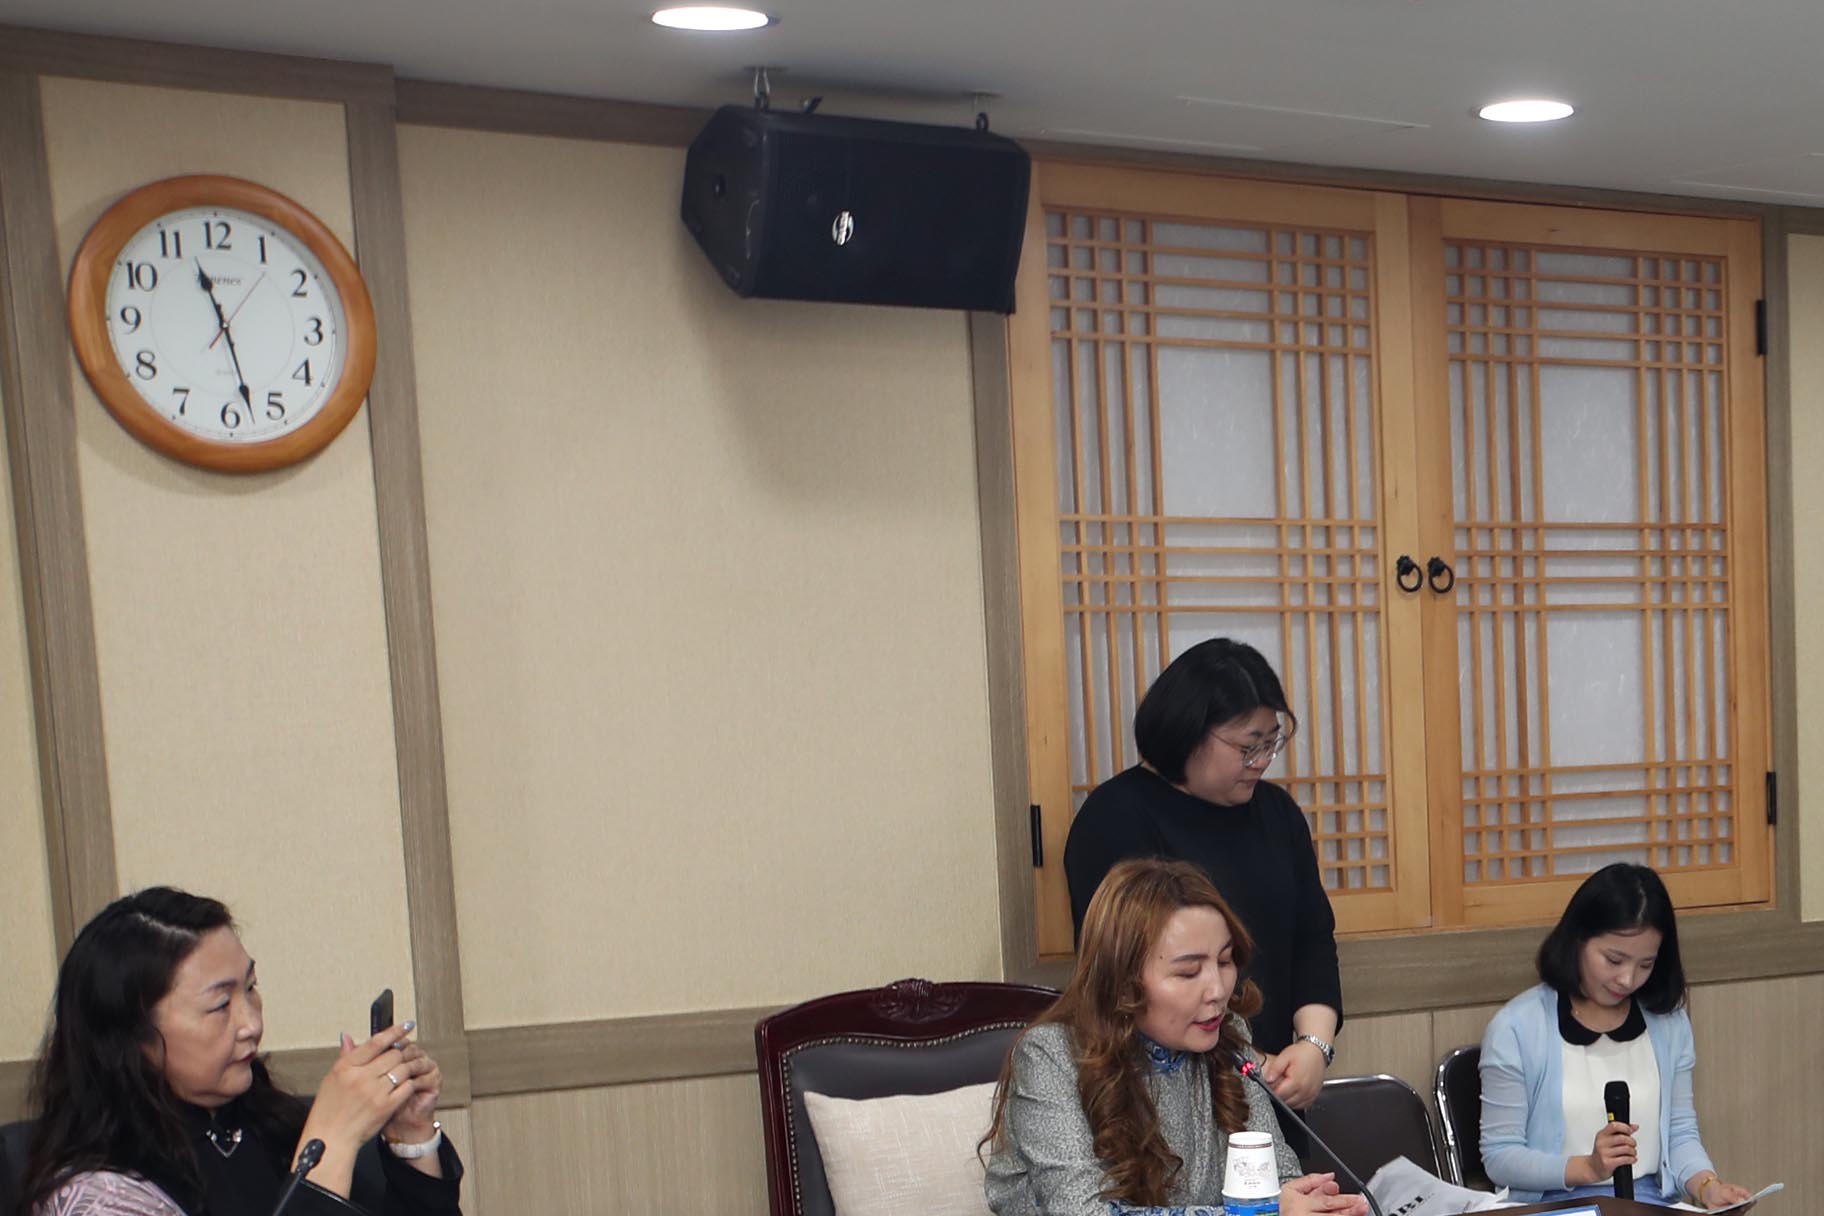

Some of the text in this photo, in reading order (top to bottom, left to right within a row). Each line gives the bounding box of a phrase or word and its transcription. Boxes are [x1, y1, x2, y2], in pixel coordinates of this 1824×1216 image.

[160, 229, 182, 259] 11
[204, 221, 231, 250] 12
[258, 236, 267, 264] 1
[127, 262, 158, 292] 10
[291, 269, 308, 298] 2
[120, 306, 142, 334] 9
[304, 317, 324, 346] 3
[136, 351, 157, 380] 8
[292, 358, 312, 386] 4
[172, 387, 190, 415] 7
[220, 402, 240, 429] 6
[266, 392, 285, 421] 5
